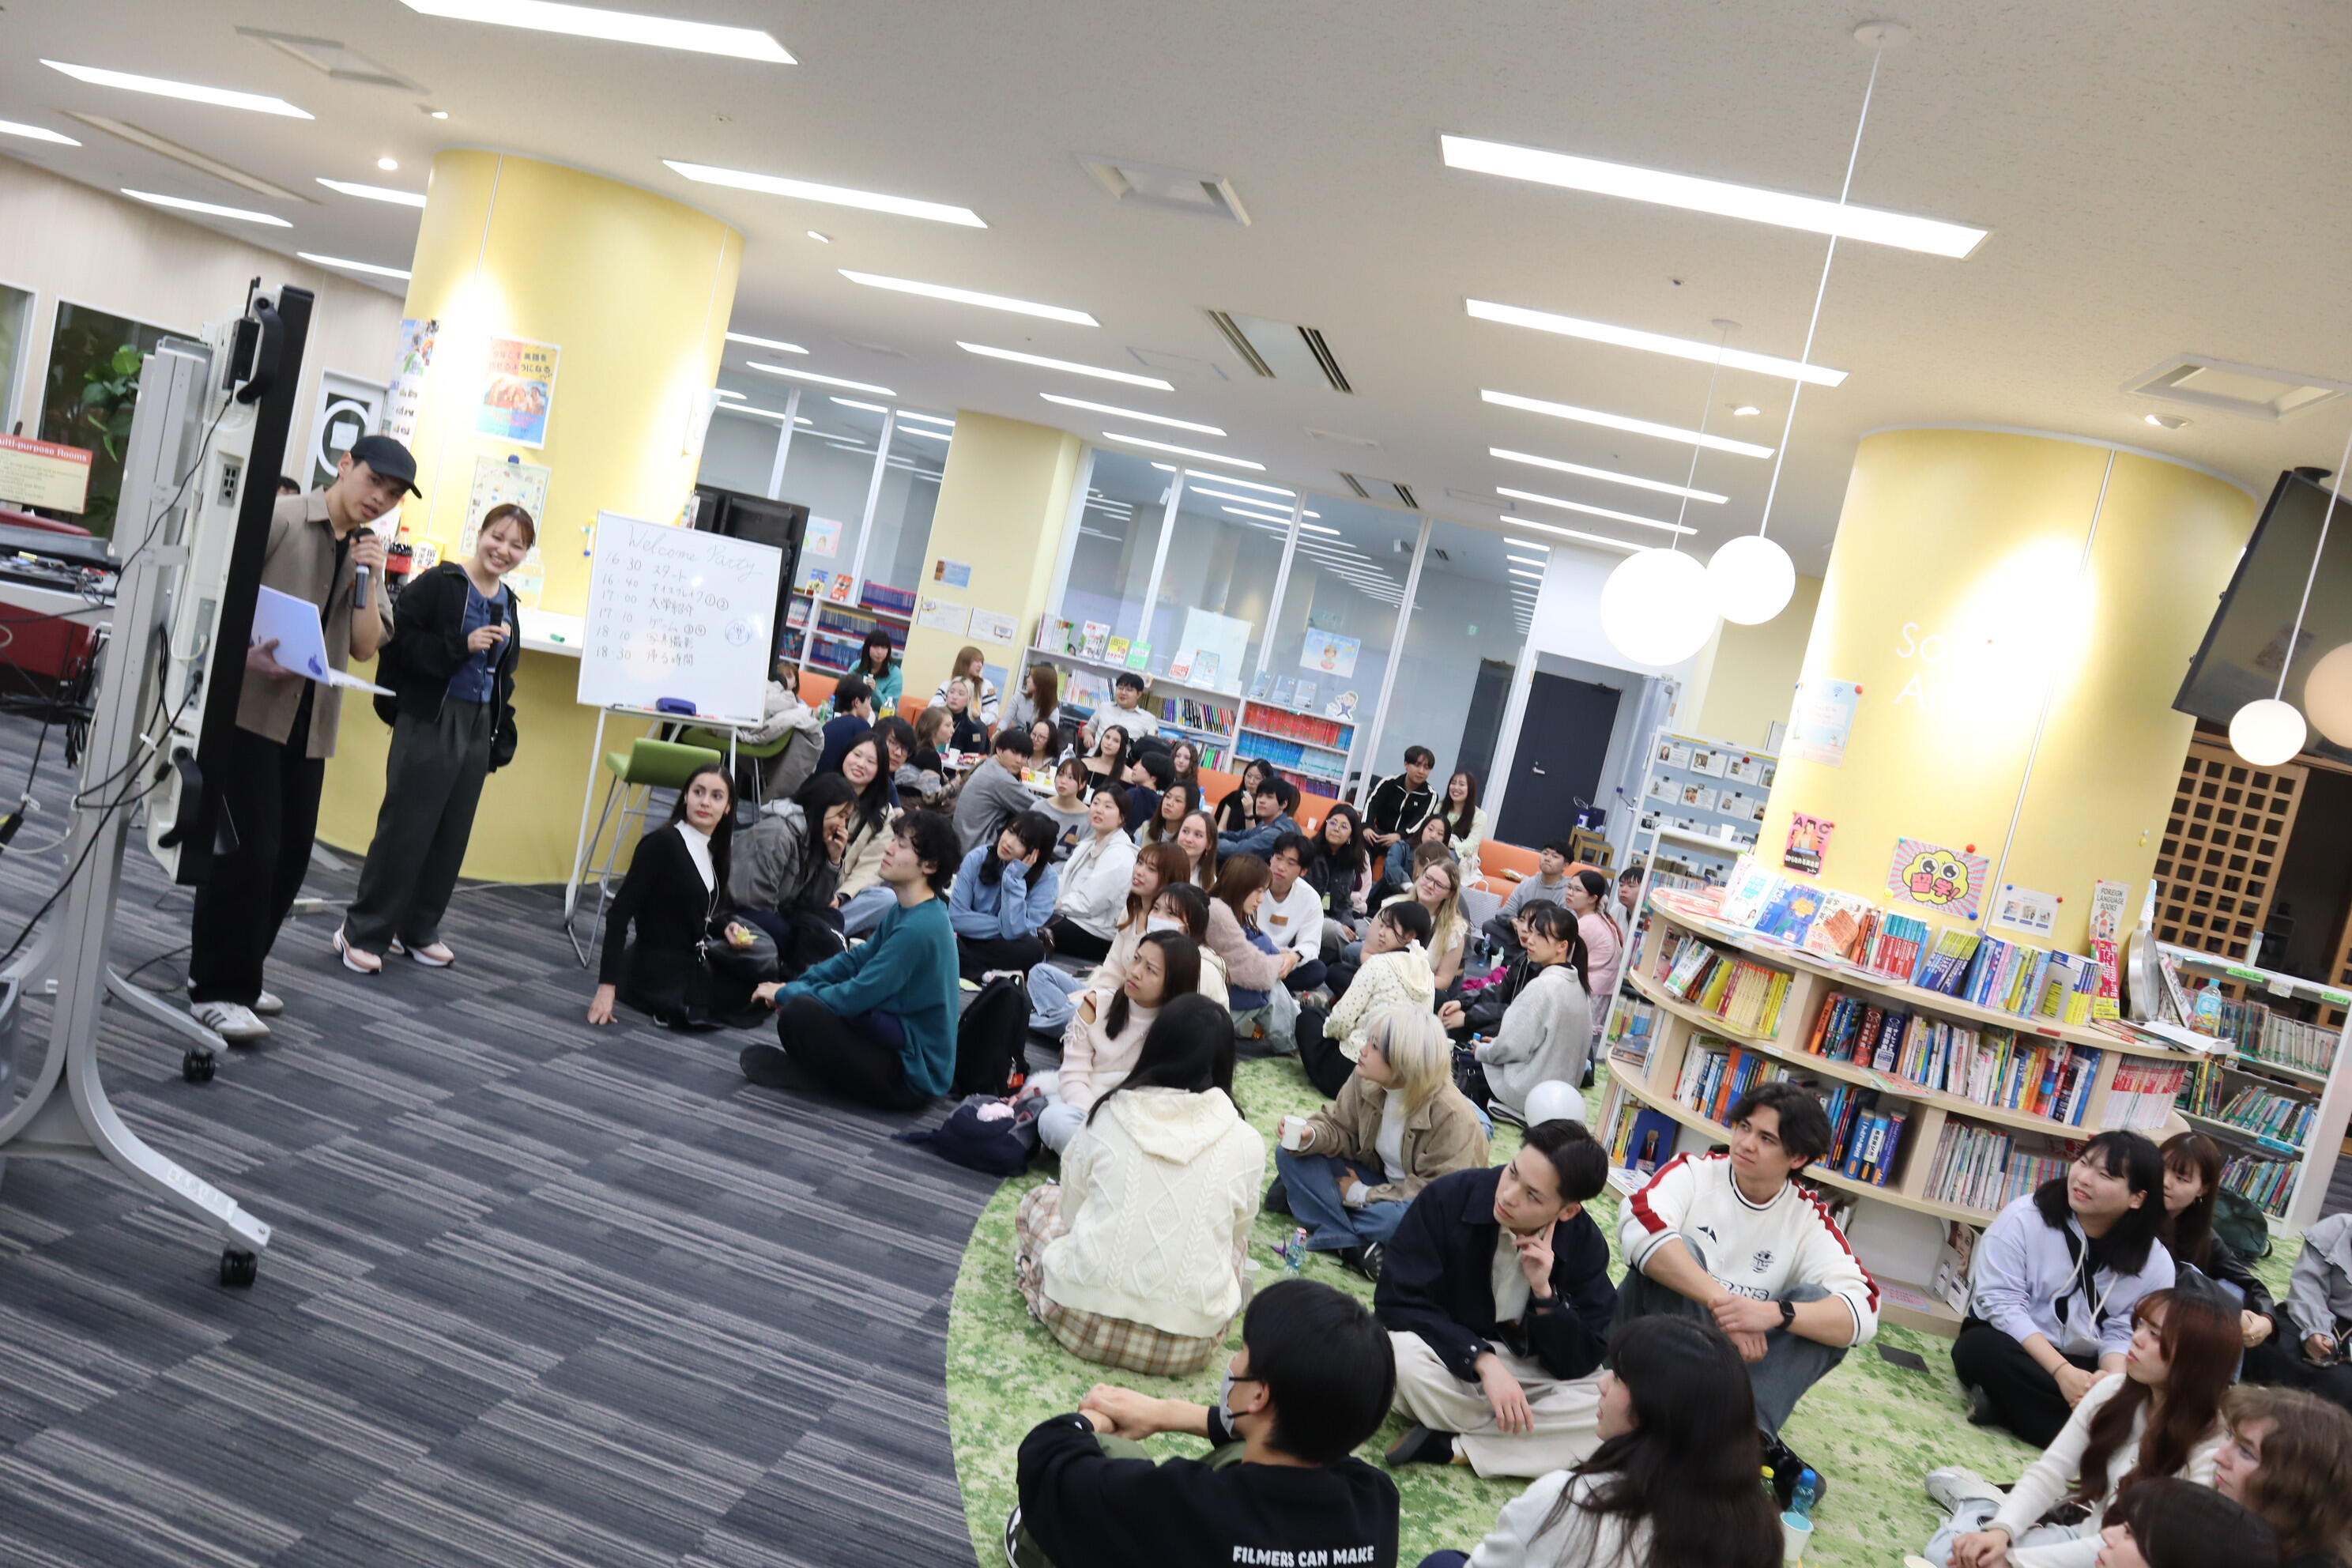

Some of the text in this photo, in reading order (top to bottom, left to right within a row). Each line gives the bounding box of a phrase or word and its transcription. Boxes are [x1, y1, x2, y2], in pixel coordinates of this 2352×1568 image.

[0, 438, 87, 462] ulti-purpose Rooms
[627, 525, 764, 582] Welcome Party
[652, 564, 688, 582] スタート
[2097, 895, 2124, 905] LANGUAGE
[2101, 887, 2124, 898] FOREIGN
[2101, 903, 2118, 911] BOOKS
[1233, 1545, 1375, 1567] FILMERS CAN MAKE
